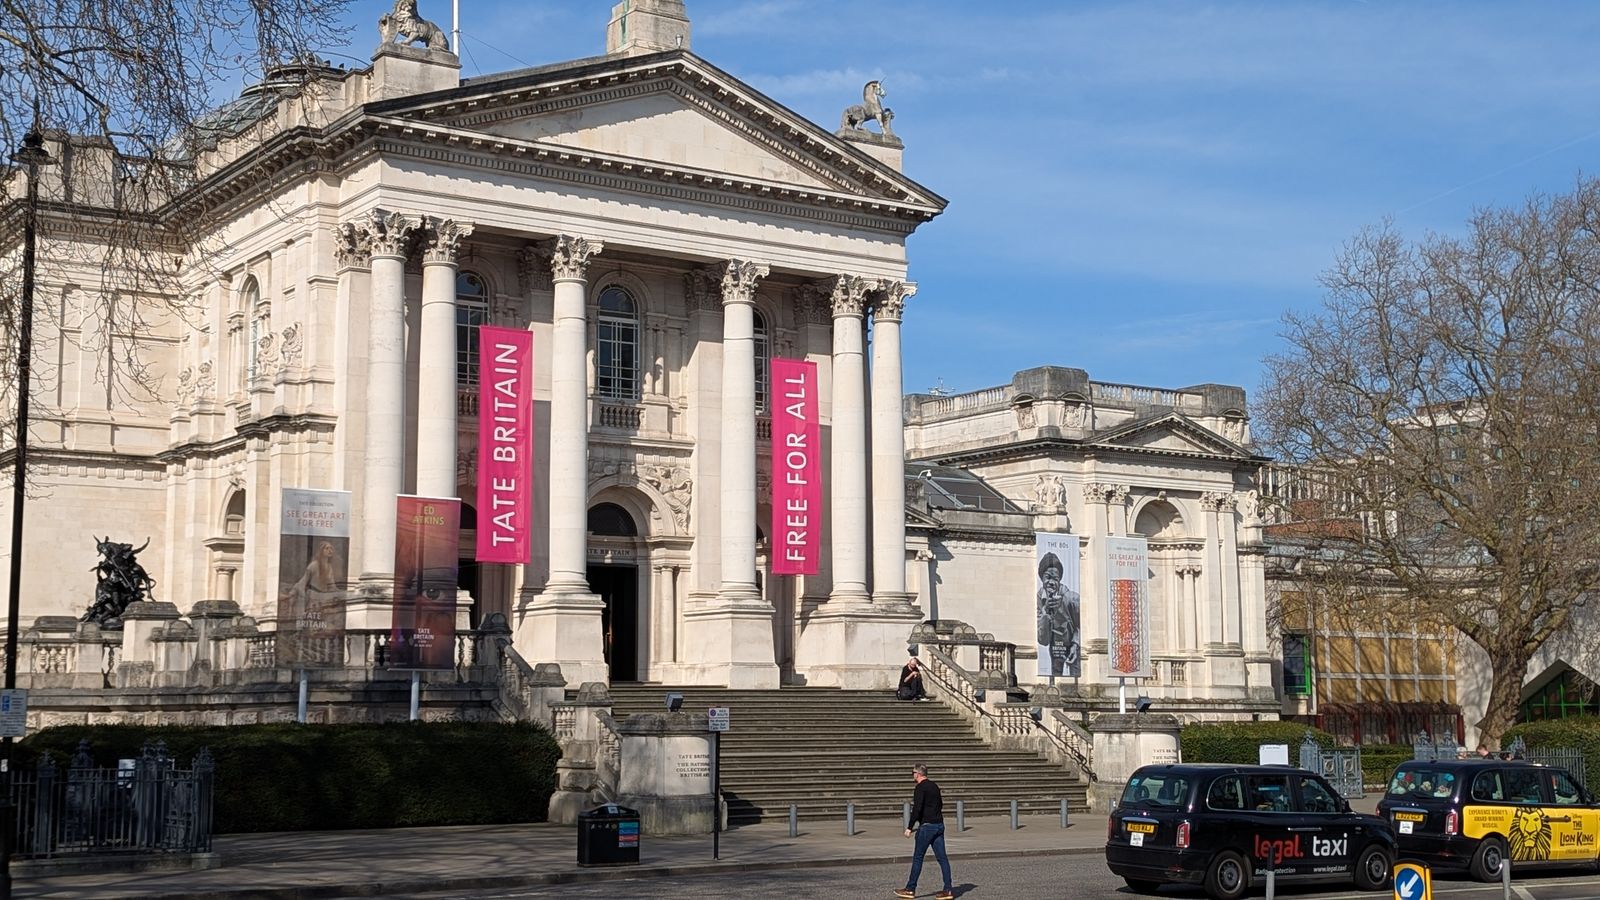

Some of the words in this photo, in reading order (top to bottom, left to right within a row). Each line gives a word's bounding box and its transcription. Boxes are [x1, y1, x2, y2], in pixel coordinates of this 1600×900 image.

[493, 343, 518, 462] BRITAIN
[785, 373, 805, 419] ALL
[786, 433, 807, 484] FOR
[287, 510, 300, 518] SEE
[303, 511, 328, 519] GREAT
[330, 512, 345, 520] ART
[412, 516, 444, 525] ATKINS
[424, 506, 434, 515] ED
[493, 478, 515, 546] TATE
[786, 499, 807, 561] FREE
[304, 612, 321, 620] TATE
[1254, 834, 1304, 864] legal.
[1312, 833, 1348, 856] taxi
